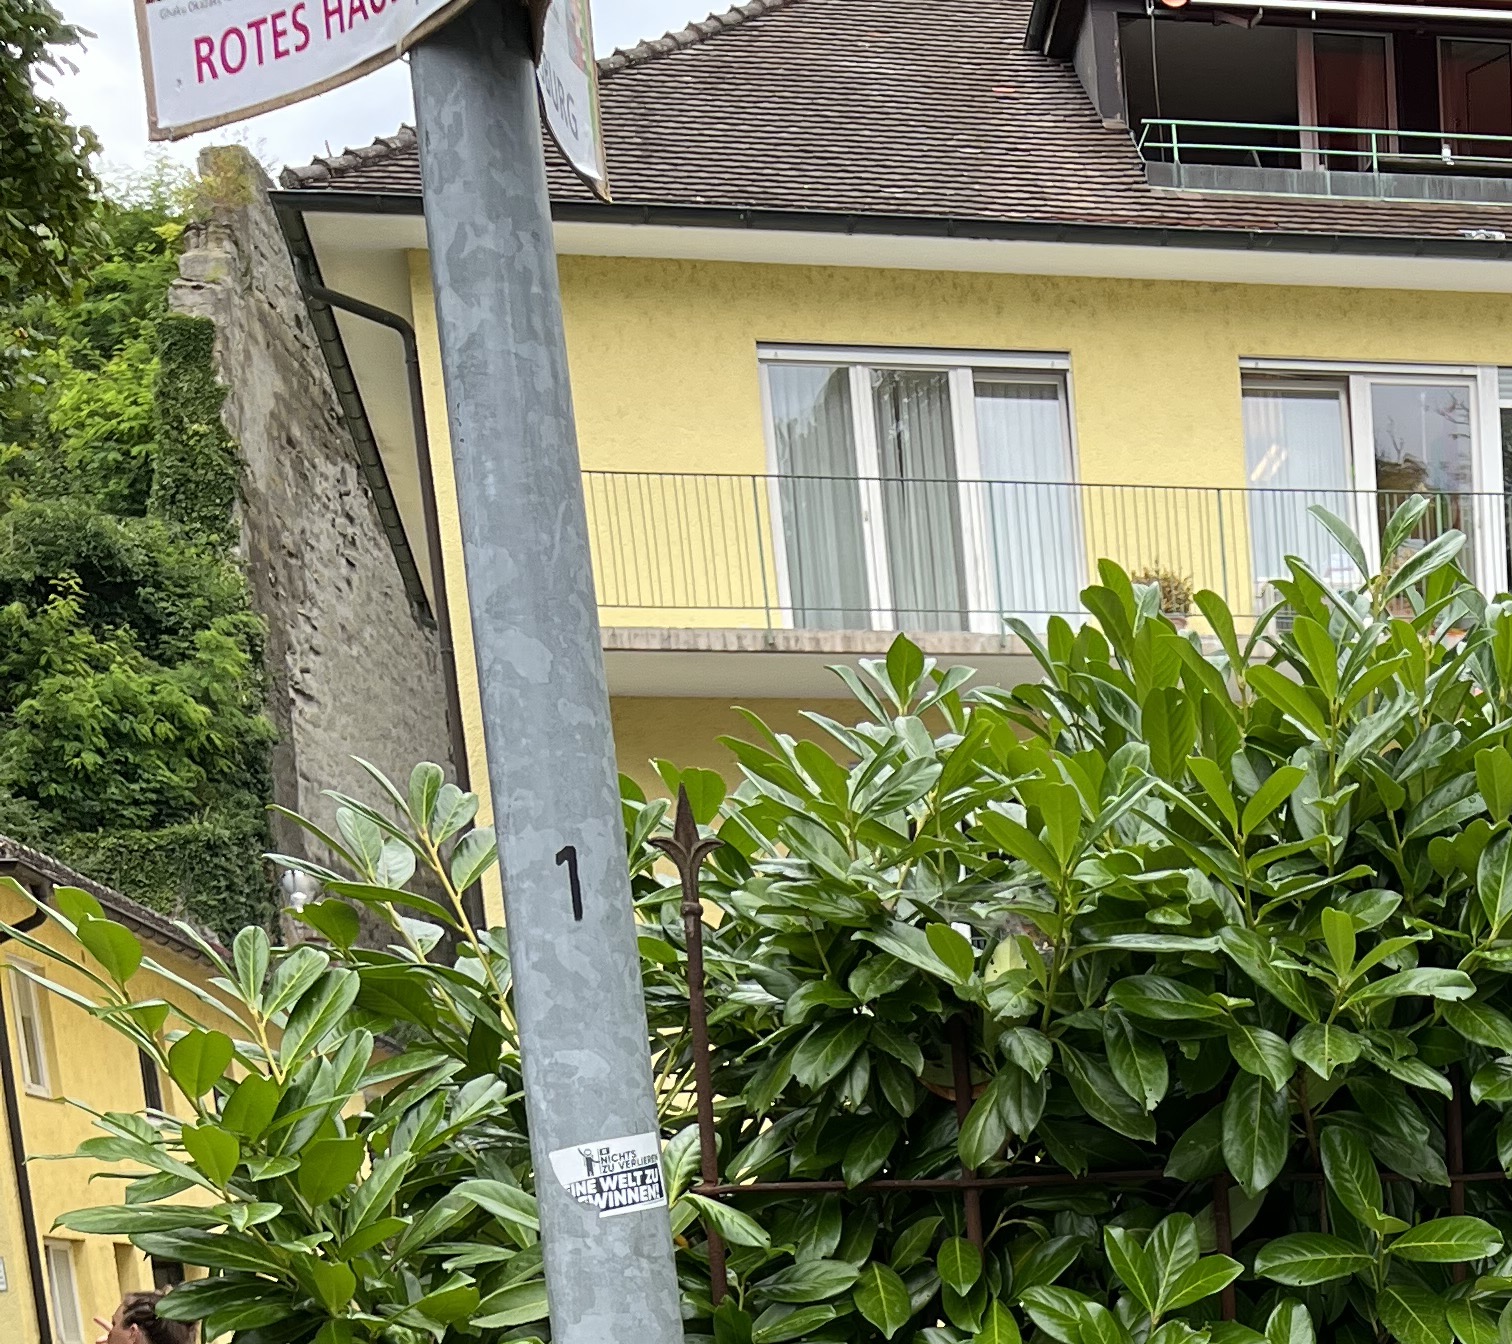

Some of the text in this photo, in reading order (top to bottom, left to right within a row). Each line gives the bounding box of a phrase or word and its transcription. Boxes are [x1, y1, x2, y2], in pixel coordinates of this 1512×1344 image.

[194, 4, 310, 83] ROTES
[556, 845, 582, 921] 1
[601, 1150, 636, 1164] NICHTS
[602, 1164, 615, 1173] ZU
[599, 1170, 643, 1192] WELT
[645, 1168, 659, 1184] ZU
[577, 1183, 661, 1209] WINNEN!
